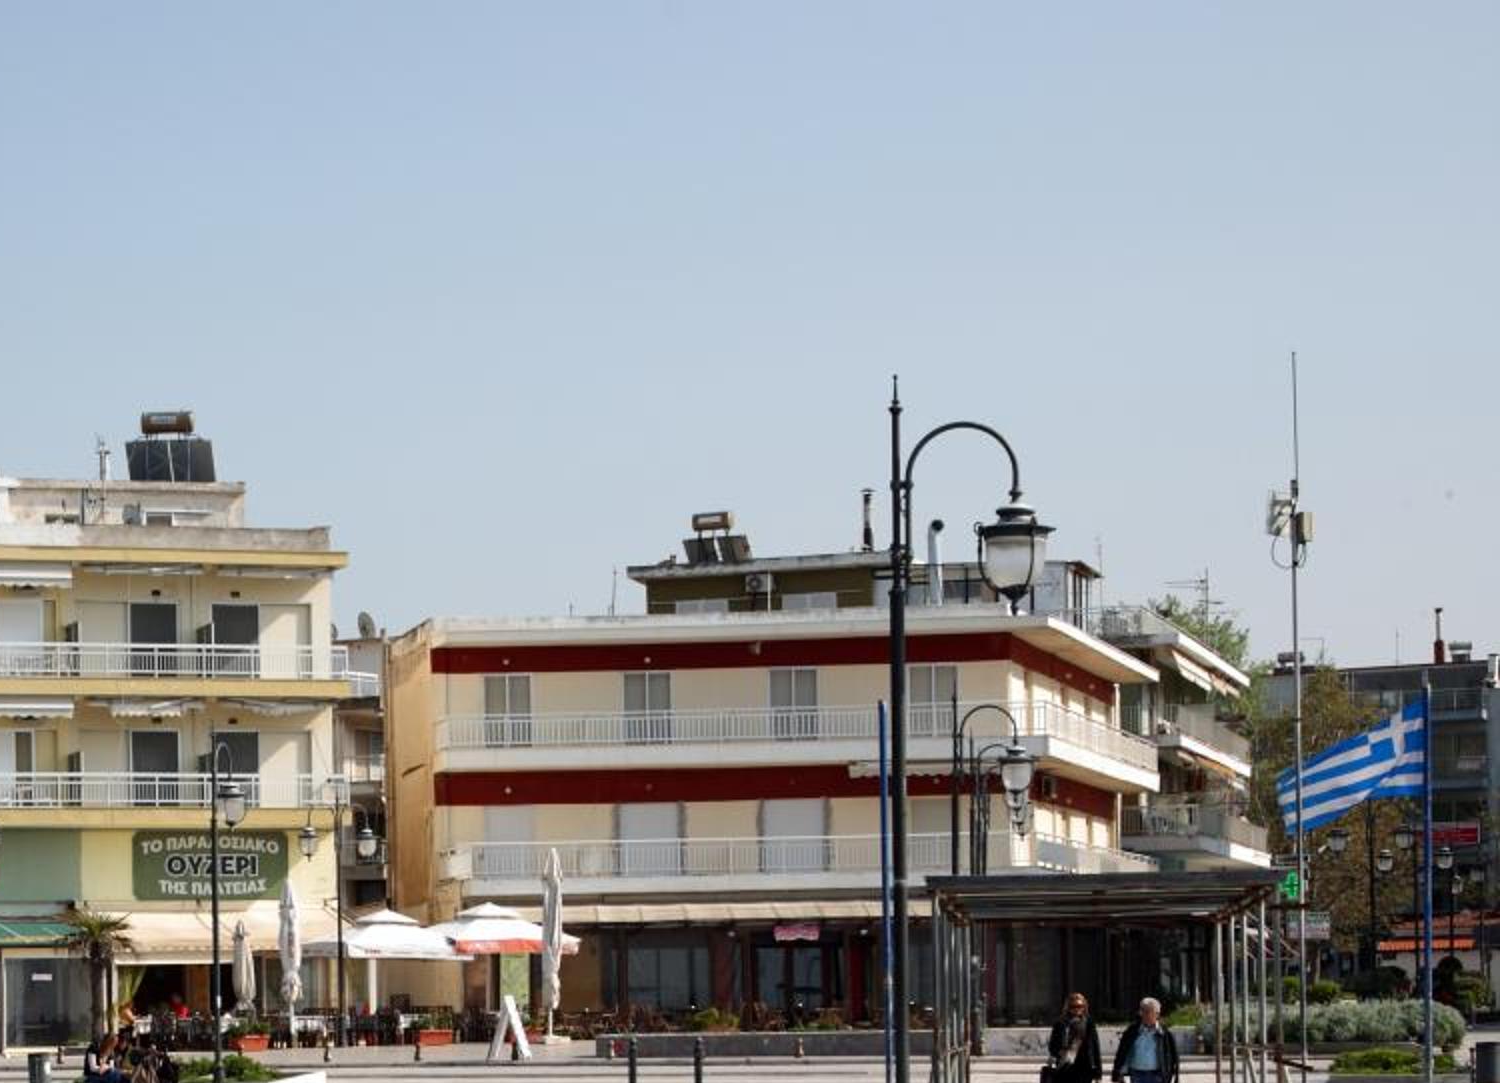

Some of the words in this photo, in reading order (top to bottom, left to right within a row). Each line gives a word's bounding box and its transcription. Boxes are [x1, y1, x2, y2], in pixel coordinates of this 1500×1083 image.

[141, 839, 163, 854] ΤΟ
[166, 835, 280, 854] ΠΑΡΑΟΣΙΑΚΟ
[158, 879, 189, 895] ΤΗΣ
